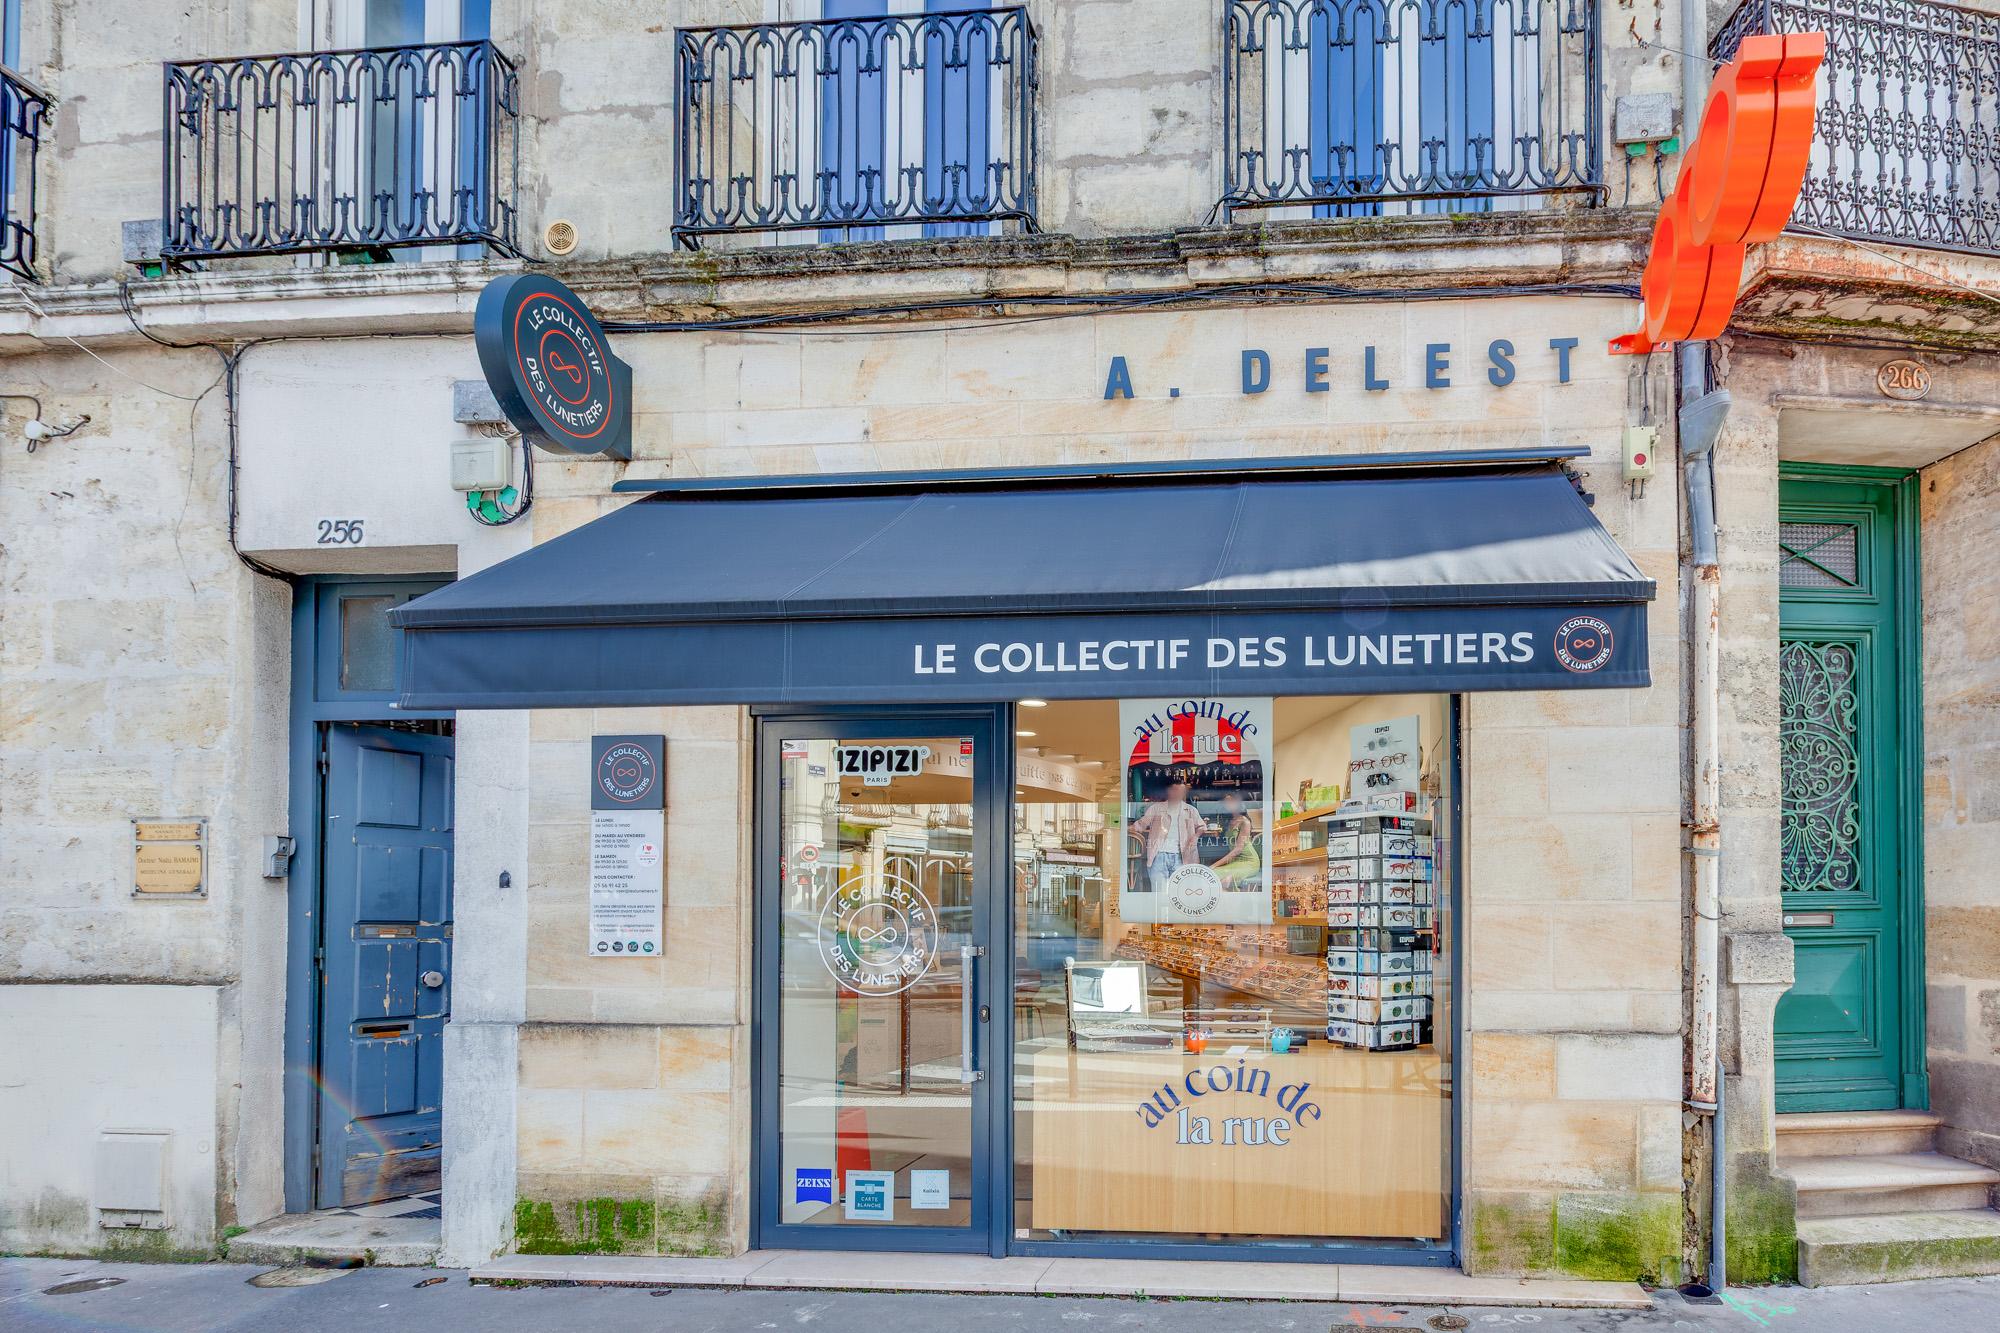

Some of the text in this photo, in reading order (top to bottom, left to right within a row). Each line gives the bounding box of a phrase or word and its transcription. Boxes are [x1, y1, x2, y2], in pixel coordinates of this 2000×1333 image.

[528, 306, 602, 376] LE COLLECTIF
[1241, 337, 1578, 394] DELEST
[1887, 366, 1924, 390] 266
[526, 357, 603, 427] DES LUNETIERS
[317, 520, 364, 544] 256
[1560, 618, 1610, 636] LE COLLECTIF
[914, 632, 1534, 674] LE COLLECTIF DES LUNETIERS
[1558, 647, 1610, 670] DES LUNETIERS
[1133, 700, 1258, 743] au coin de
[1160, 728, 1236, 754] la rue
[605, 748, 650, 766] LE COLLECTIF
[838, 750, 918, 772] IZIPIZI
[604, 778, 650, 798] DES LUNETIERS
[1172, 868, 1216, 884] LE COLLECTIF
[832, 884, 926, 922] LE COLECTIF
[1172, 896, 1216, 915] DES LUNETIERS
[830, 945, 924, 986] DES LUNETIERS
[1136, 1058, 1322, 1128] au coin de
[1176, 1107, 1290, 1146] la rue
[797, 1178, 831, 1188] ZEISS
